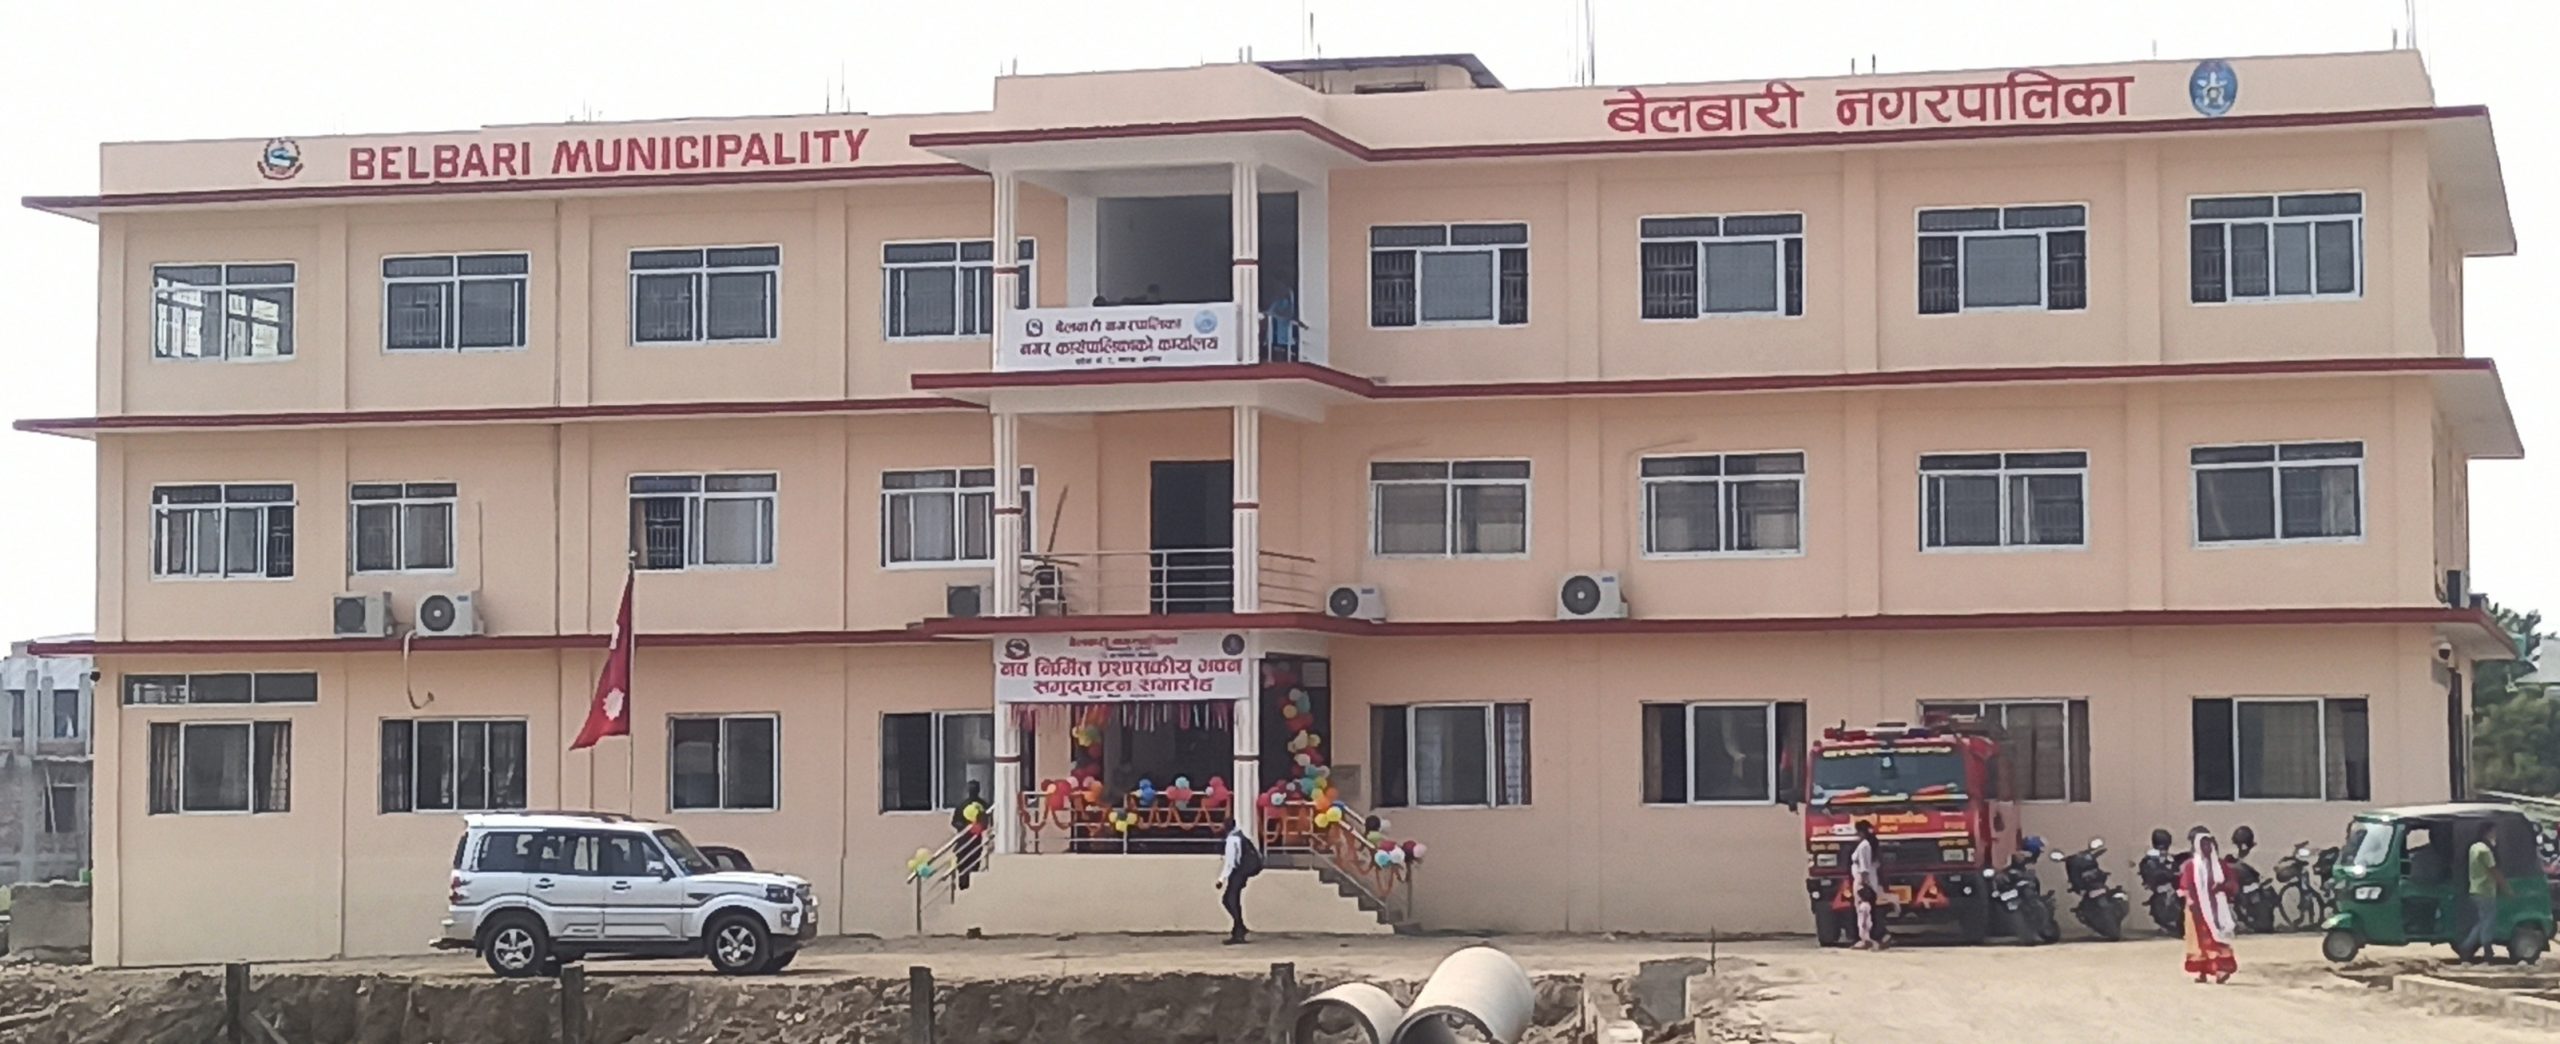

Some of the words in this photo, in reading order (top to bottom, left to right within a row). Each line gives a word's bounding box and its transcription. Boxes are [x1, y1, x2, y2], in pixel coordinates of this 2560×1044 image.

[1604, 81, 1804, 134] बेलबारी
[1836, 70, 2136, 126] नगरपालिका
[349, 141, 532, 181] BELBARI
[551, 128, 871, 175] MUNICIPALITY
[1055, 318, 1101, 333] बेलबारी
[1105, 316, 1182, 331] नगरपालिका
[1020, 341, 1051, 356] नगर
[1158, 334, 1219, 352] कार्यालय
[1000, 661, 1027, 677] नव
[1035, 656, 1091, 677] निर्मित
[1197, 658, 1243, 675] भवन
[1139, 673, 1215, 693] समारोह
